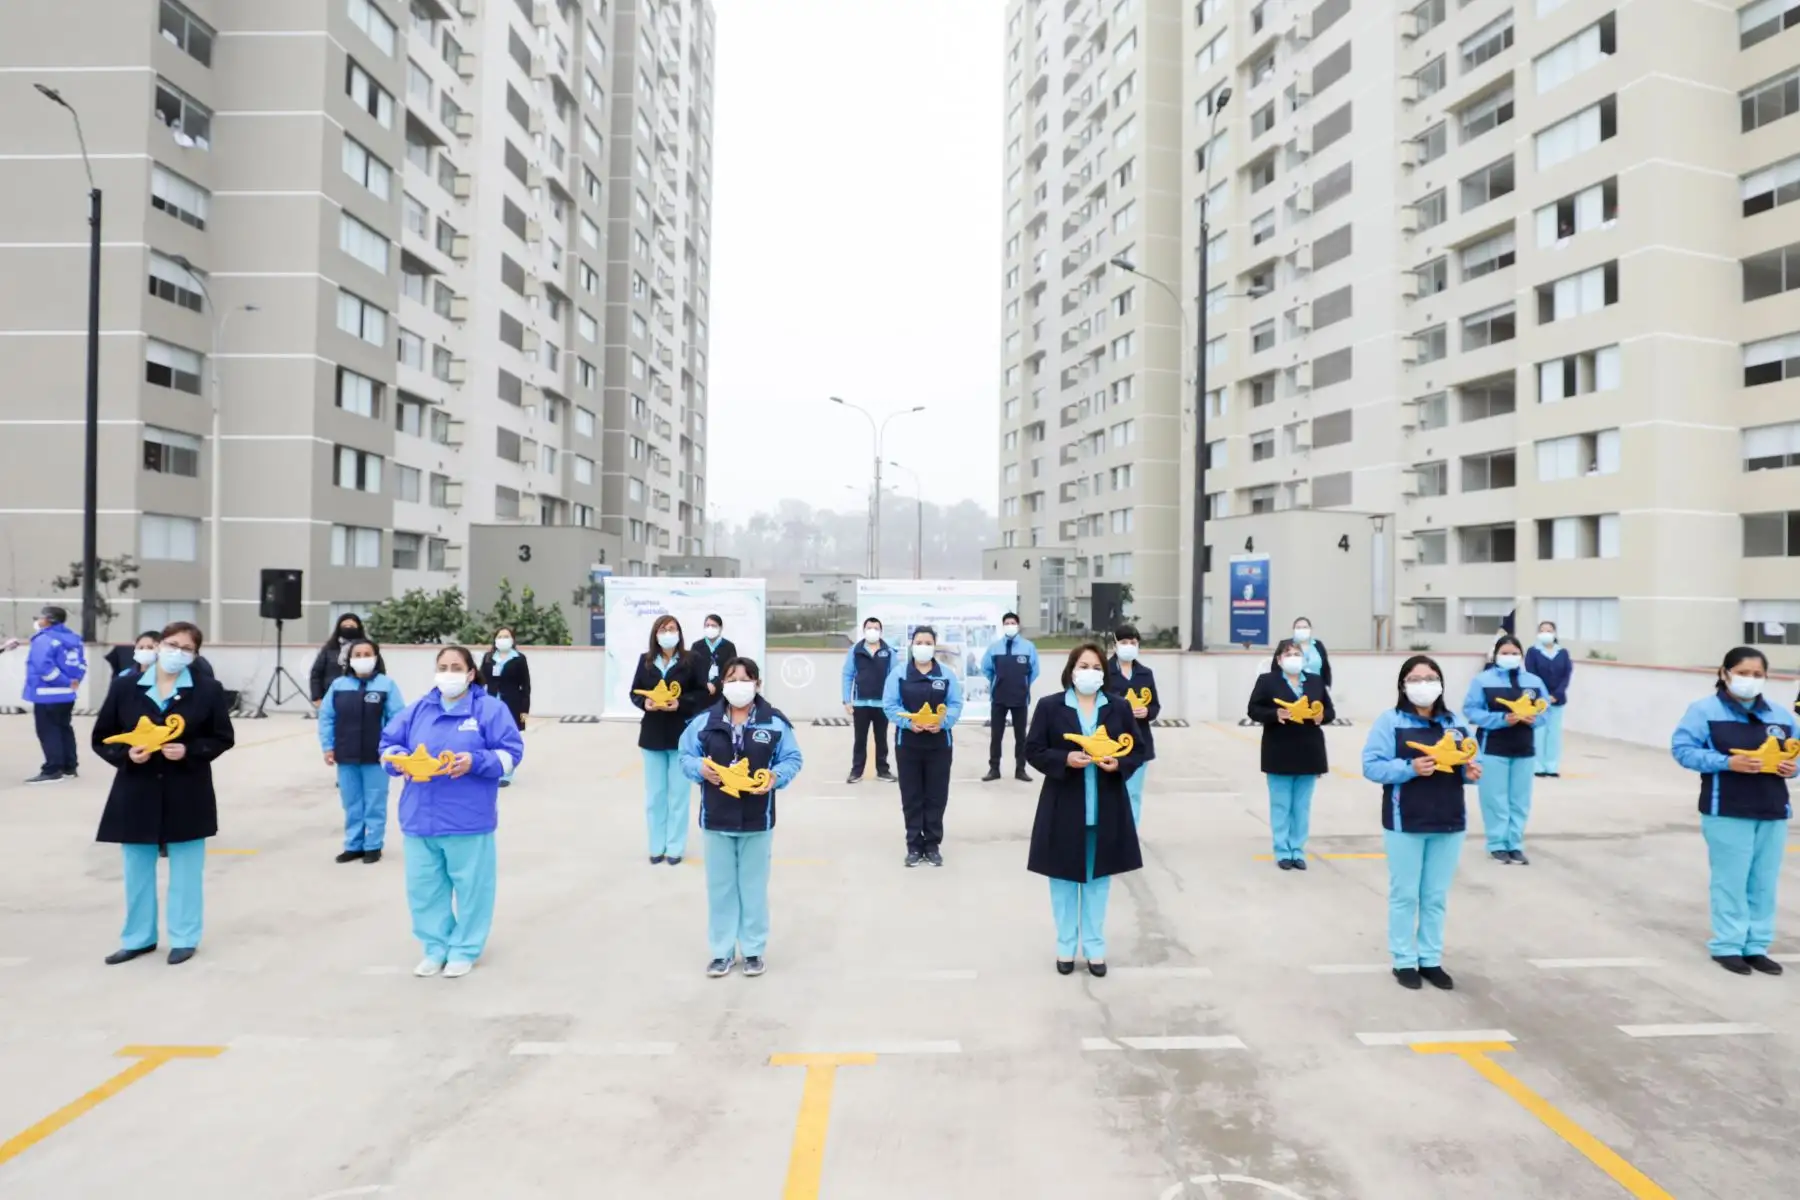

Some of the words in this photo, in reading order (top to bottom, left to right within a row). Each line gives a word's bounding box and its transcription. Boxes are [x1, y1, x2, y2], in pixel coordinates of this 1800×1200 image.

[1245, 536, 1254, 552] 4
[1338, 534, 1350, 552] 4
[518, 544, 532, 562] 3
[1022, 559, 1031, 570] 4
